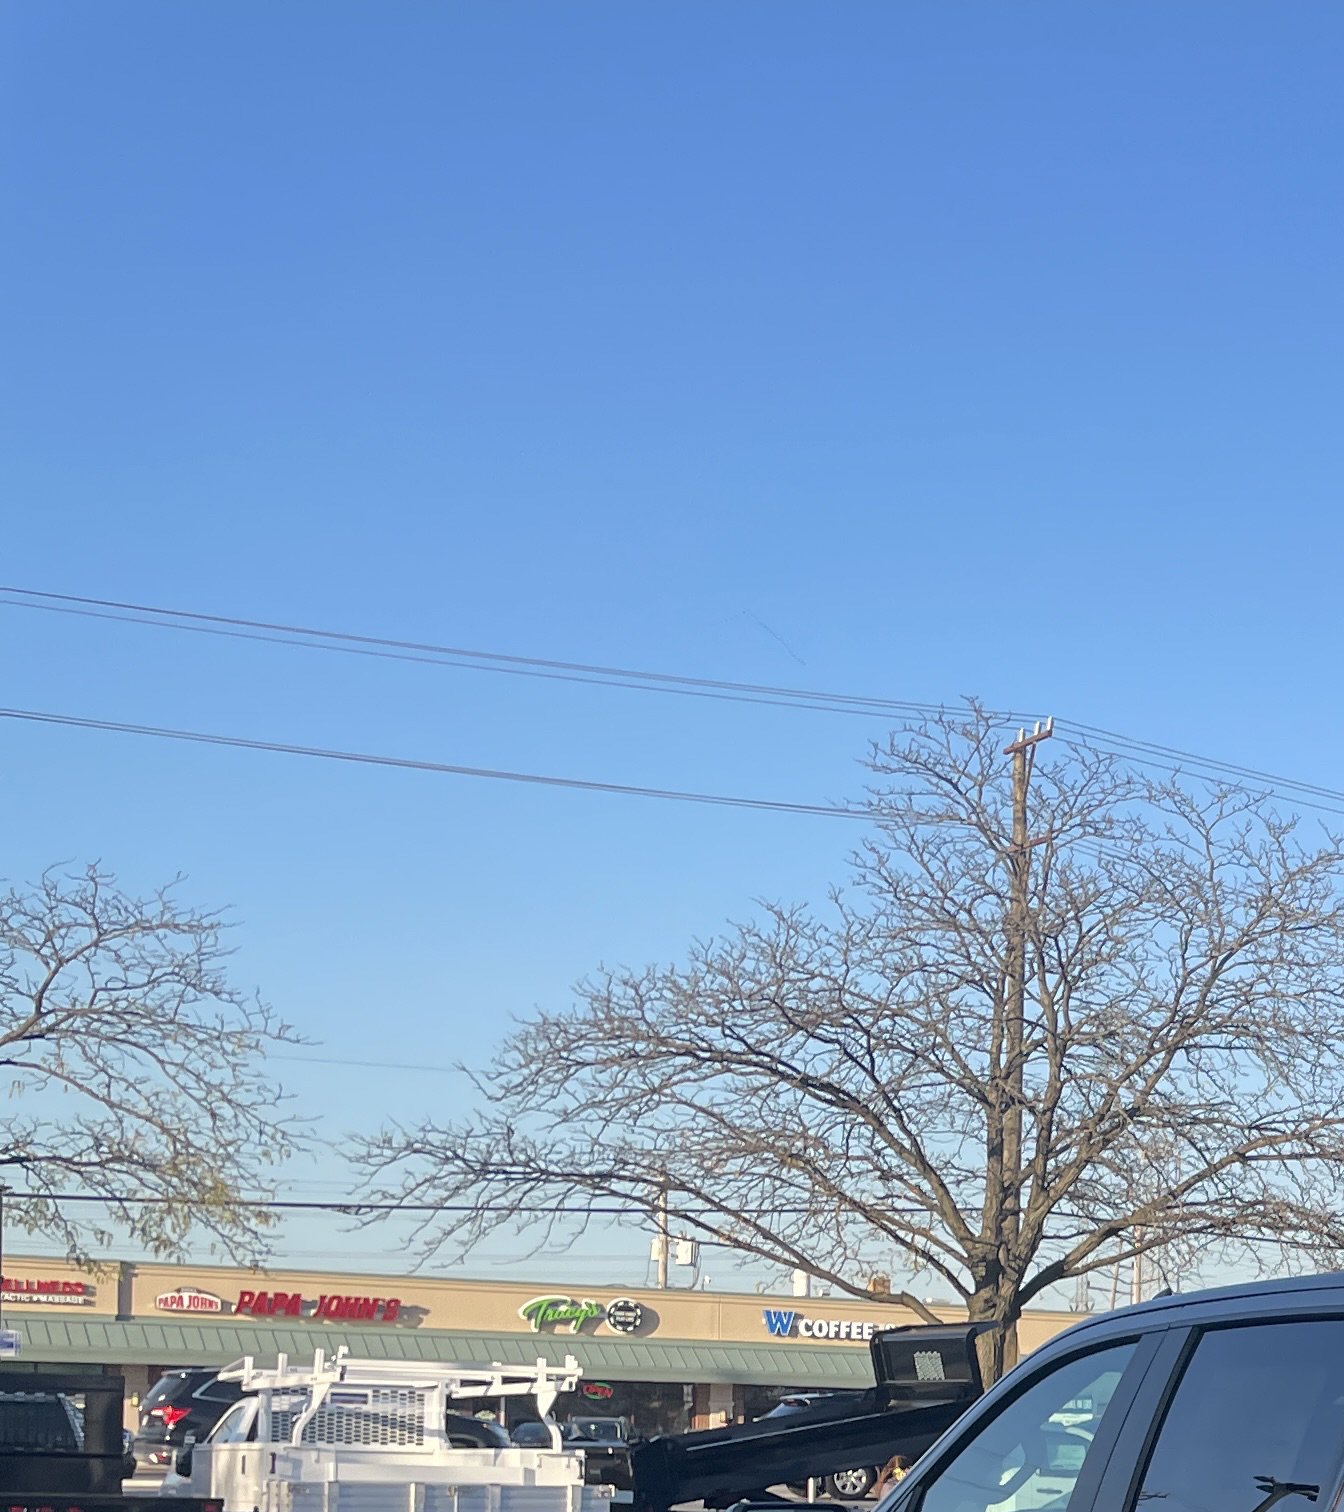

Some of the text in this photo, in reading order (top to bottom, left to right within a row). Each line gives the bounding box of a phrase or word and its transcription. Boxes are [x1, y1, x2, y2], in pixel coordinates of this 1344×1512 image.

[158, 1295, 184, 1308] PAPA
[235, 1291, 401, 1321] PAPA JOHN'S
[763, 1309, 874, 1340] W COFFEE
